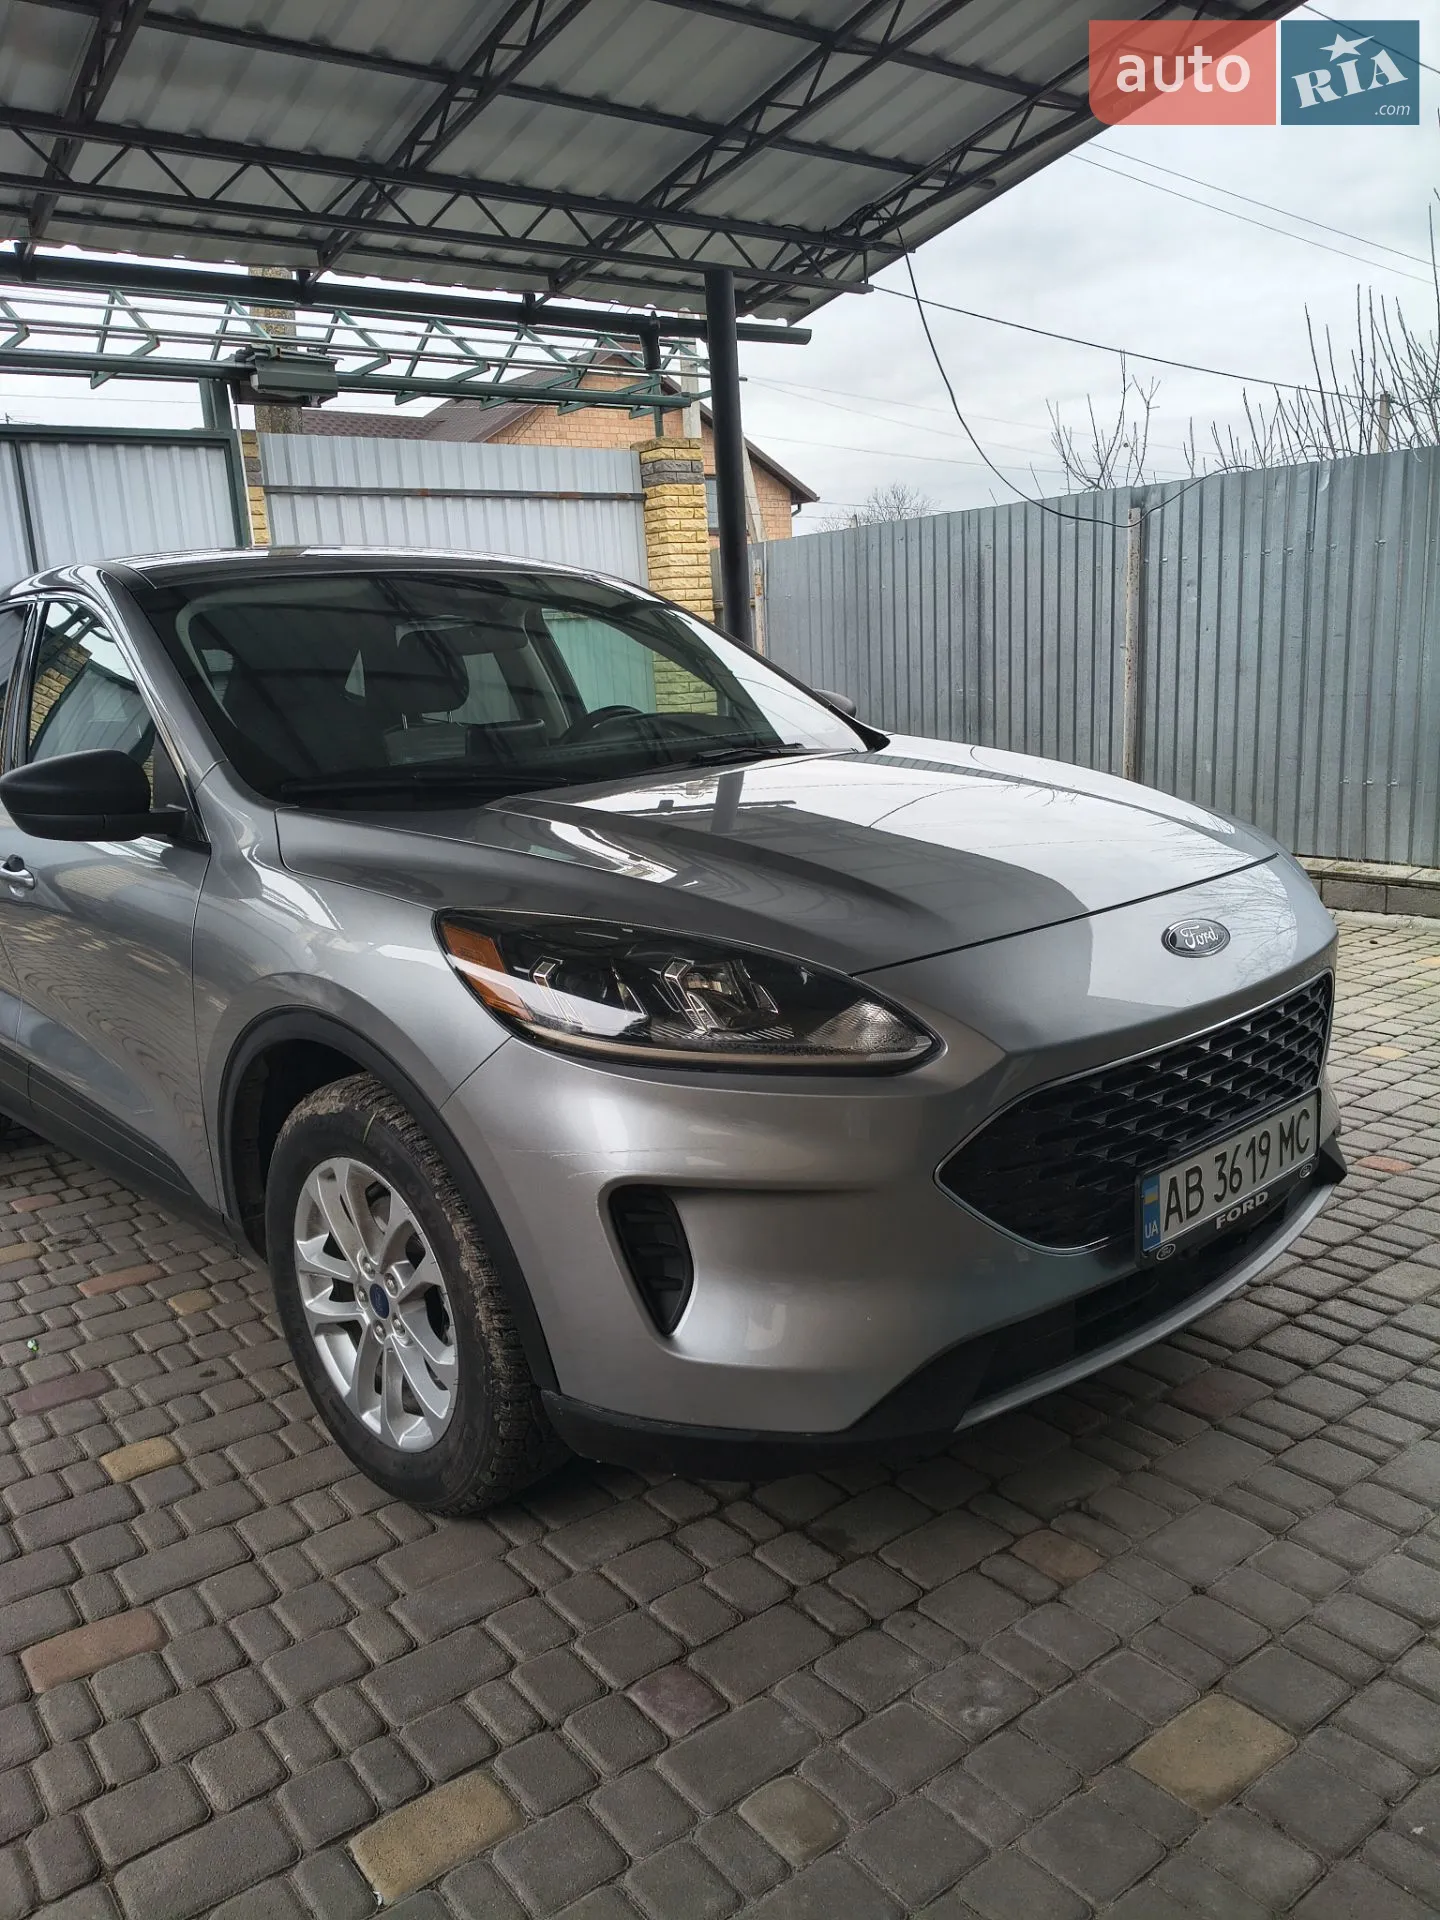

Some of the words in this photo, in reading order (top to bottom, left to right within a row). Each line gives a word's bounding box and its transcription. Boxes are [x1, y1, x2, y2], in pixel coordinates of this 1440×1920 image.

[1180, 925, 1219, 949] Ford
[1163, 1165, 1205, 1232] AB
[1213, 1129, 1271, 1203] 3619
[1279, 1108, 1311, 1167] MC
[1215, 1191, 1269, 1230] FORD
[1144, 1220, 1159, 1239] UA
